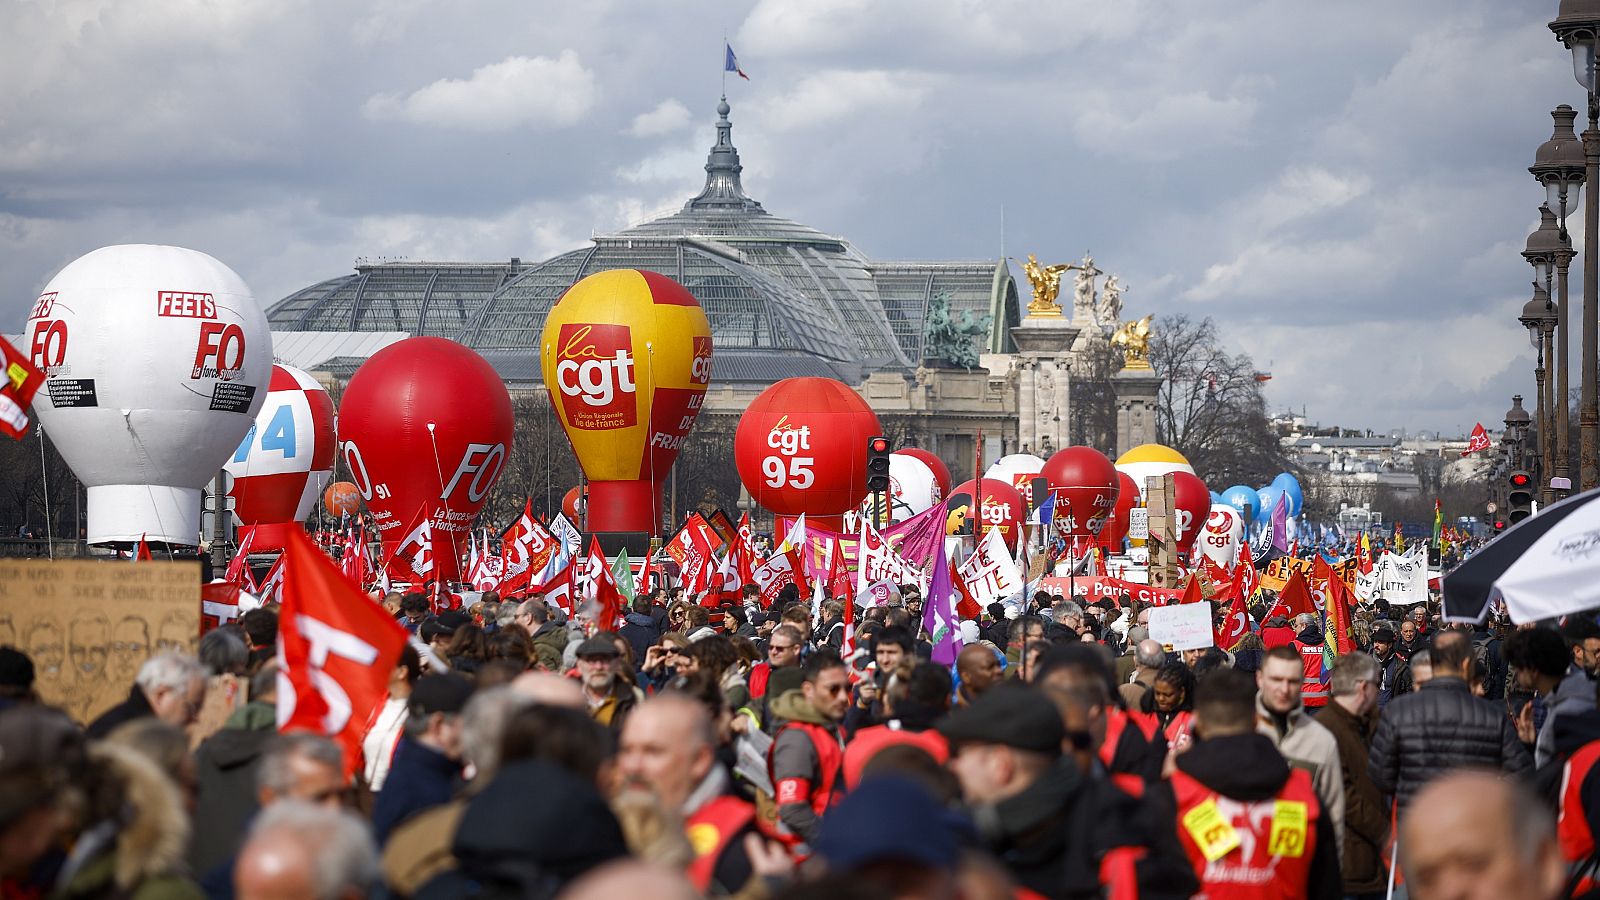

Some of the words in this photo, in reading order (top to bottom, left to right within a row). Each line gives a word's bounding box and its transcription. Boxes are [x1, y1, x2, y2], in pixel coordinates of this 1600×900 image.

[159, 293, 215, 317] FEETS
[30, 320, 67, 376] FO
[191, 321, 245, 379] FO
[558, 325, 598, 359] la
[557, 349, 637, 406] cgt
[692, 356, 712, 384] cg
[770, 415, 792, 431] la
[767, 425, 810, 456] cgt
[339, 441, 373, 500] O
[440, 442, 505, 502] FO
[762, 456, 815, 489] 95
[375, 483, 391, 500] 91
[1015, 484, 1033, 501] cg
[434, 507, 444, 519] La
[445, 509, 466, 521] Force
[981, 503, 1012, 524] cgt
[1054, 514, 1079, 534] cgt
[1207, 533, 1231, 548] cgt
[865, 554, 903, 584] Eiffel
[1094, 582, 1130, 597] Paris
